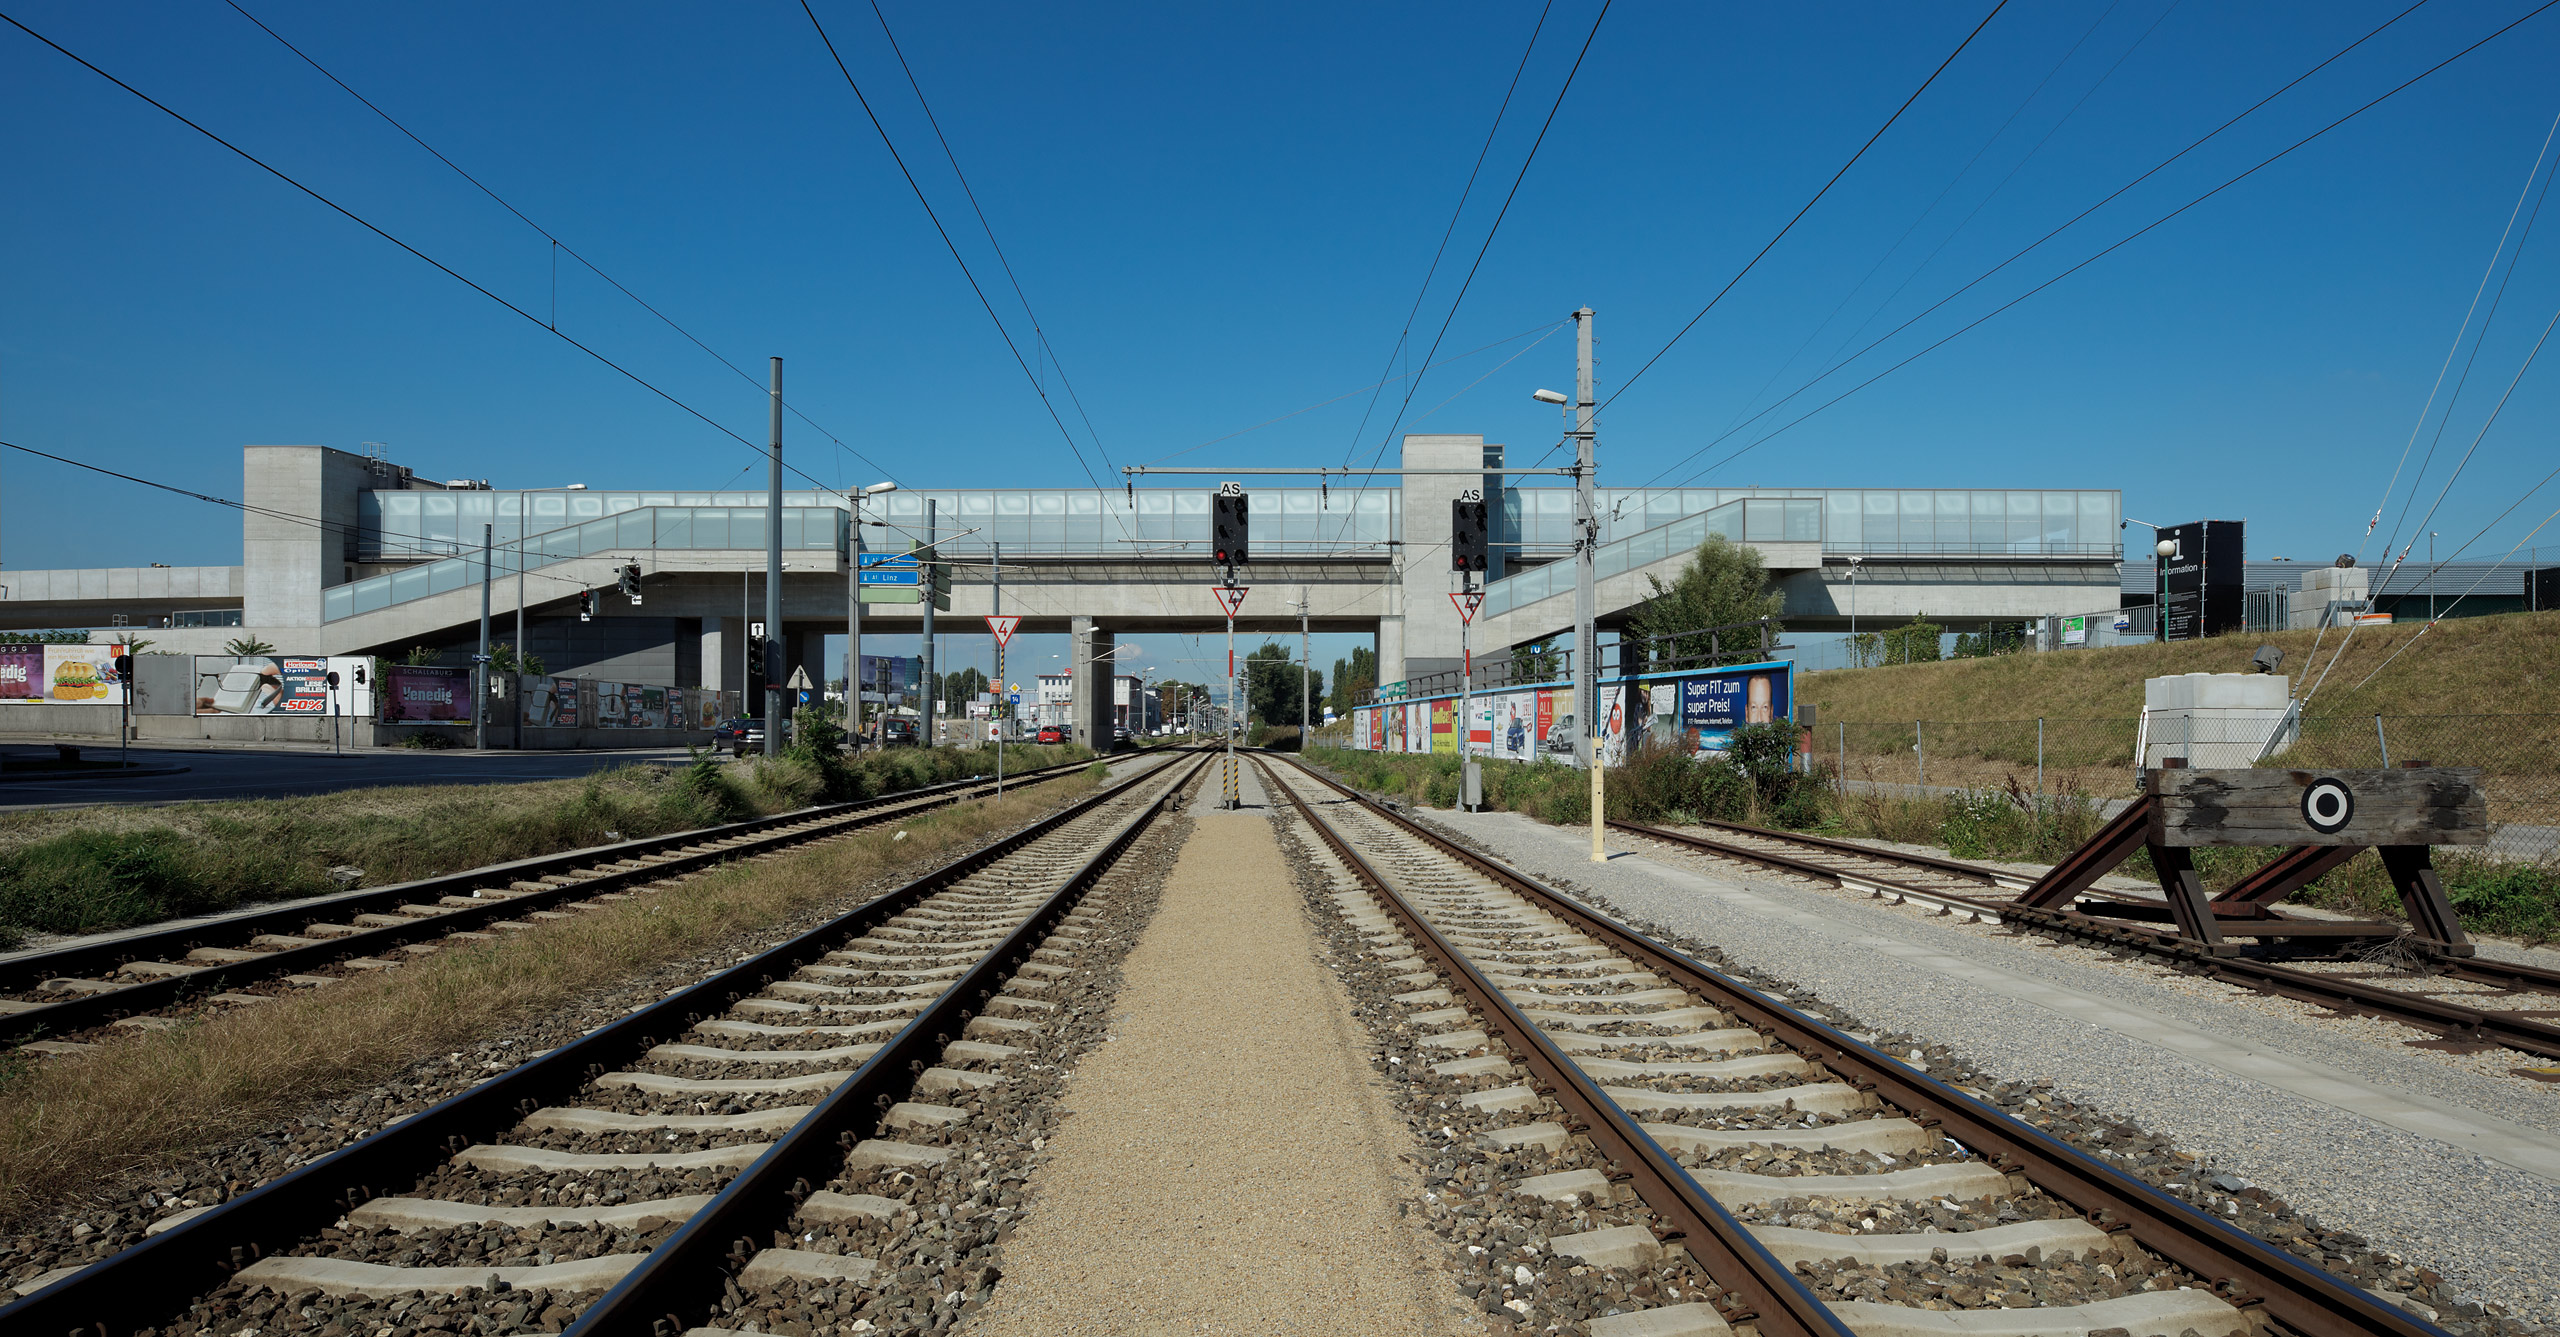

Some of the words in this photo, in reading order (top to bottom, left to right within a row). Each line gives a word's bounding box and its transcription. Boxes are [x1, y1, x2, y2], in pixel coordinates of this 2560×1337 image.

[1221, 484, 1240, 495] AS
[1461, 489, 1480, 500] AS
[2160, 564, 2198, 576] Inormation
[998, 620, 1008, 636] 4
[403, 686, 453, 705] Venedig
[1687, 682, 1708, 698] Super
[1710, 680, 1722, 694] FIT
[1723, 681, 1740, 694] zum
[280, 699, 325, 710] -50%
[1539, 701, 1552, 716] ALL
[1687, 701, 1707, 715] super
[1708, 698, 1730, 713] Preis!
[1596, 748, 1602, 758] F
